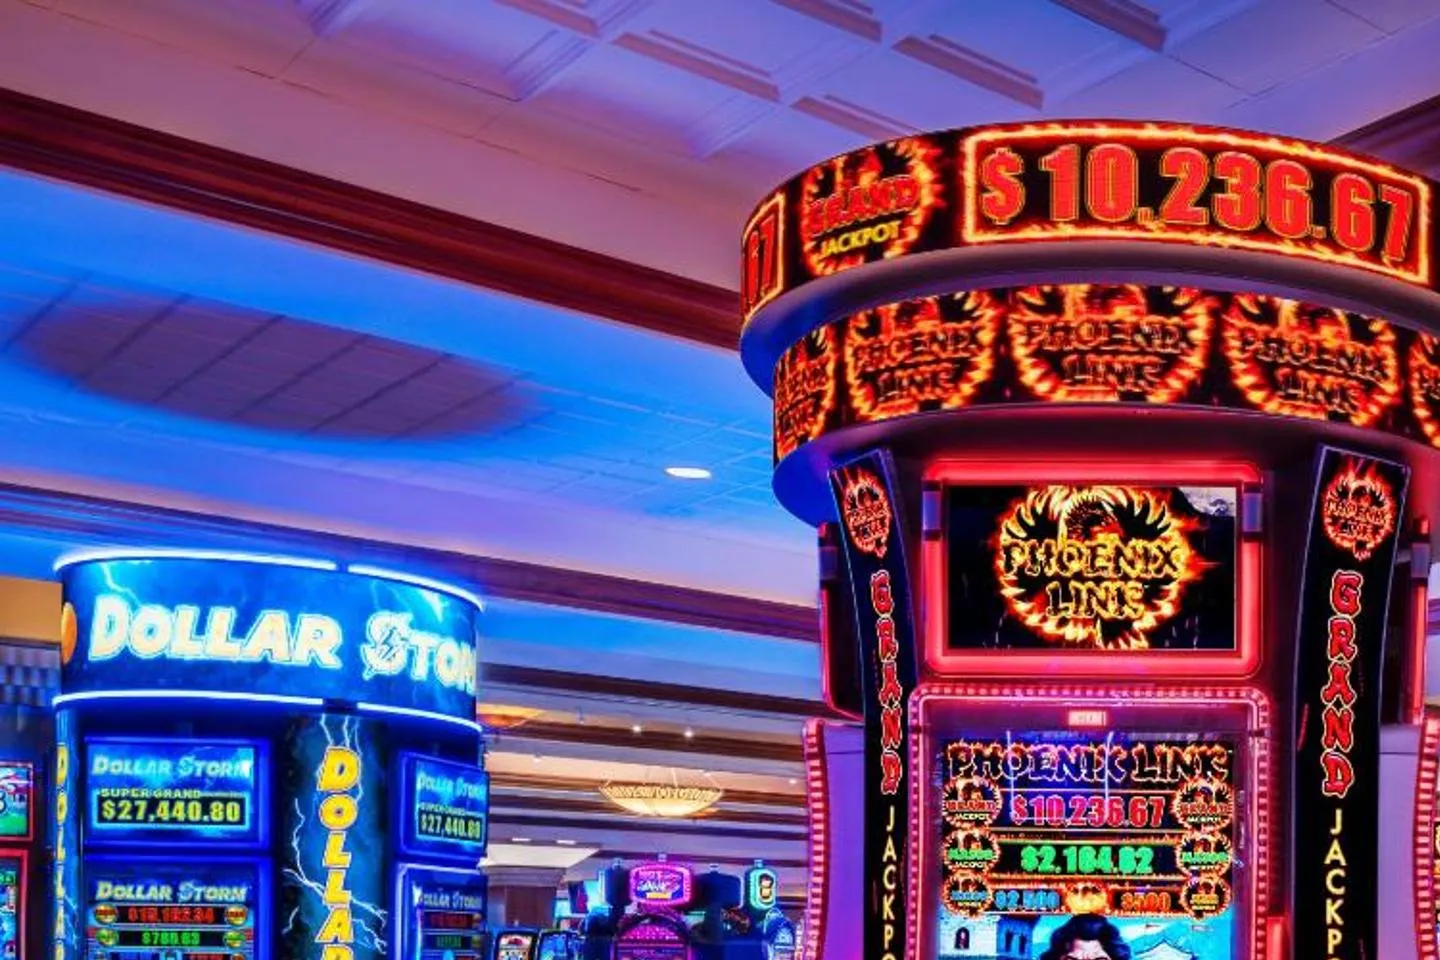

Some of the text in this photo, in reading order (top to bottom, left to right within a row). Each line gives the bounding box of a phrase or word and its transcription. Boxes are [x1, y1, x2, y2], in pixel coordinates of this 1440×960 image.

[822, 220, 901, 257] JACKPOT
[1001, 539, 1181, 579] PHOENIX
[1045, 580, 1145, 620] LINK
[88, 594, 477, 698] DOLLAR STOR
[870, 569, 902, 795] GRAND
[1320, 569, 1365, 798] GRAND
[93, 754, 172, 777] DOLLAR
[947, 741, 1230, 783] PHOENIX LINK
[102, 800, 241, 823] $27,440.80
[1011, 794, 1165, 828] $10,236.67
[96, 880, 249, 904] DOLLAR STORM
